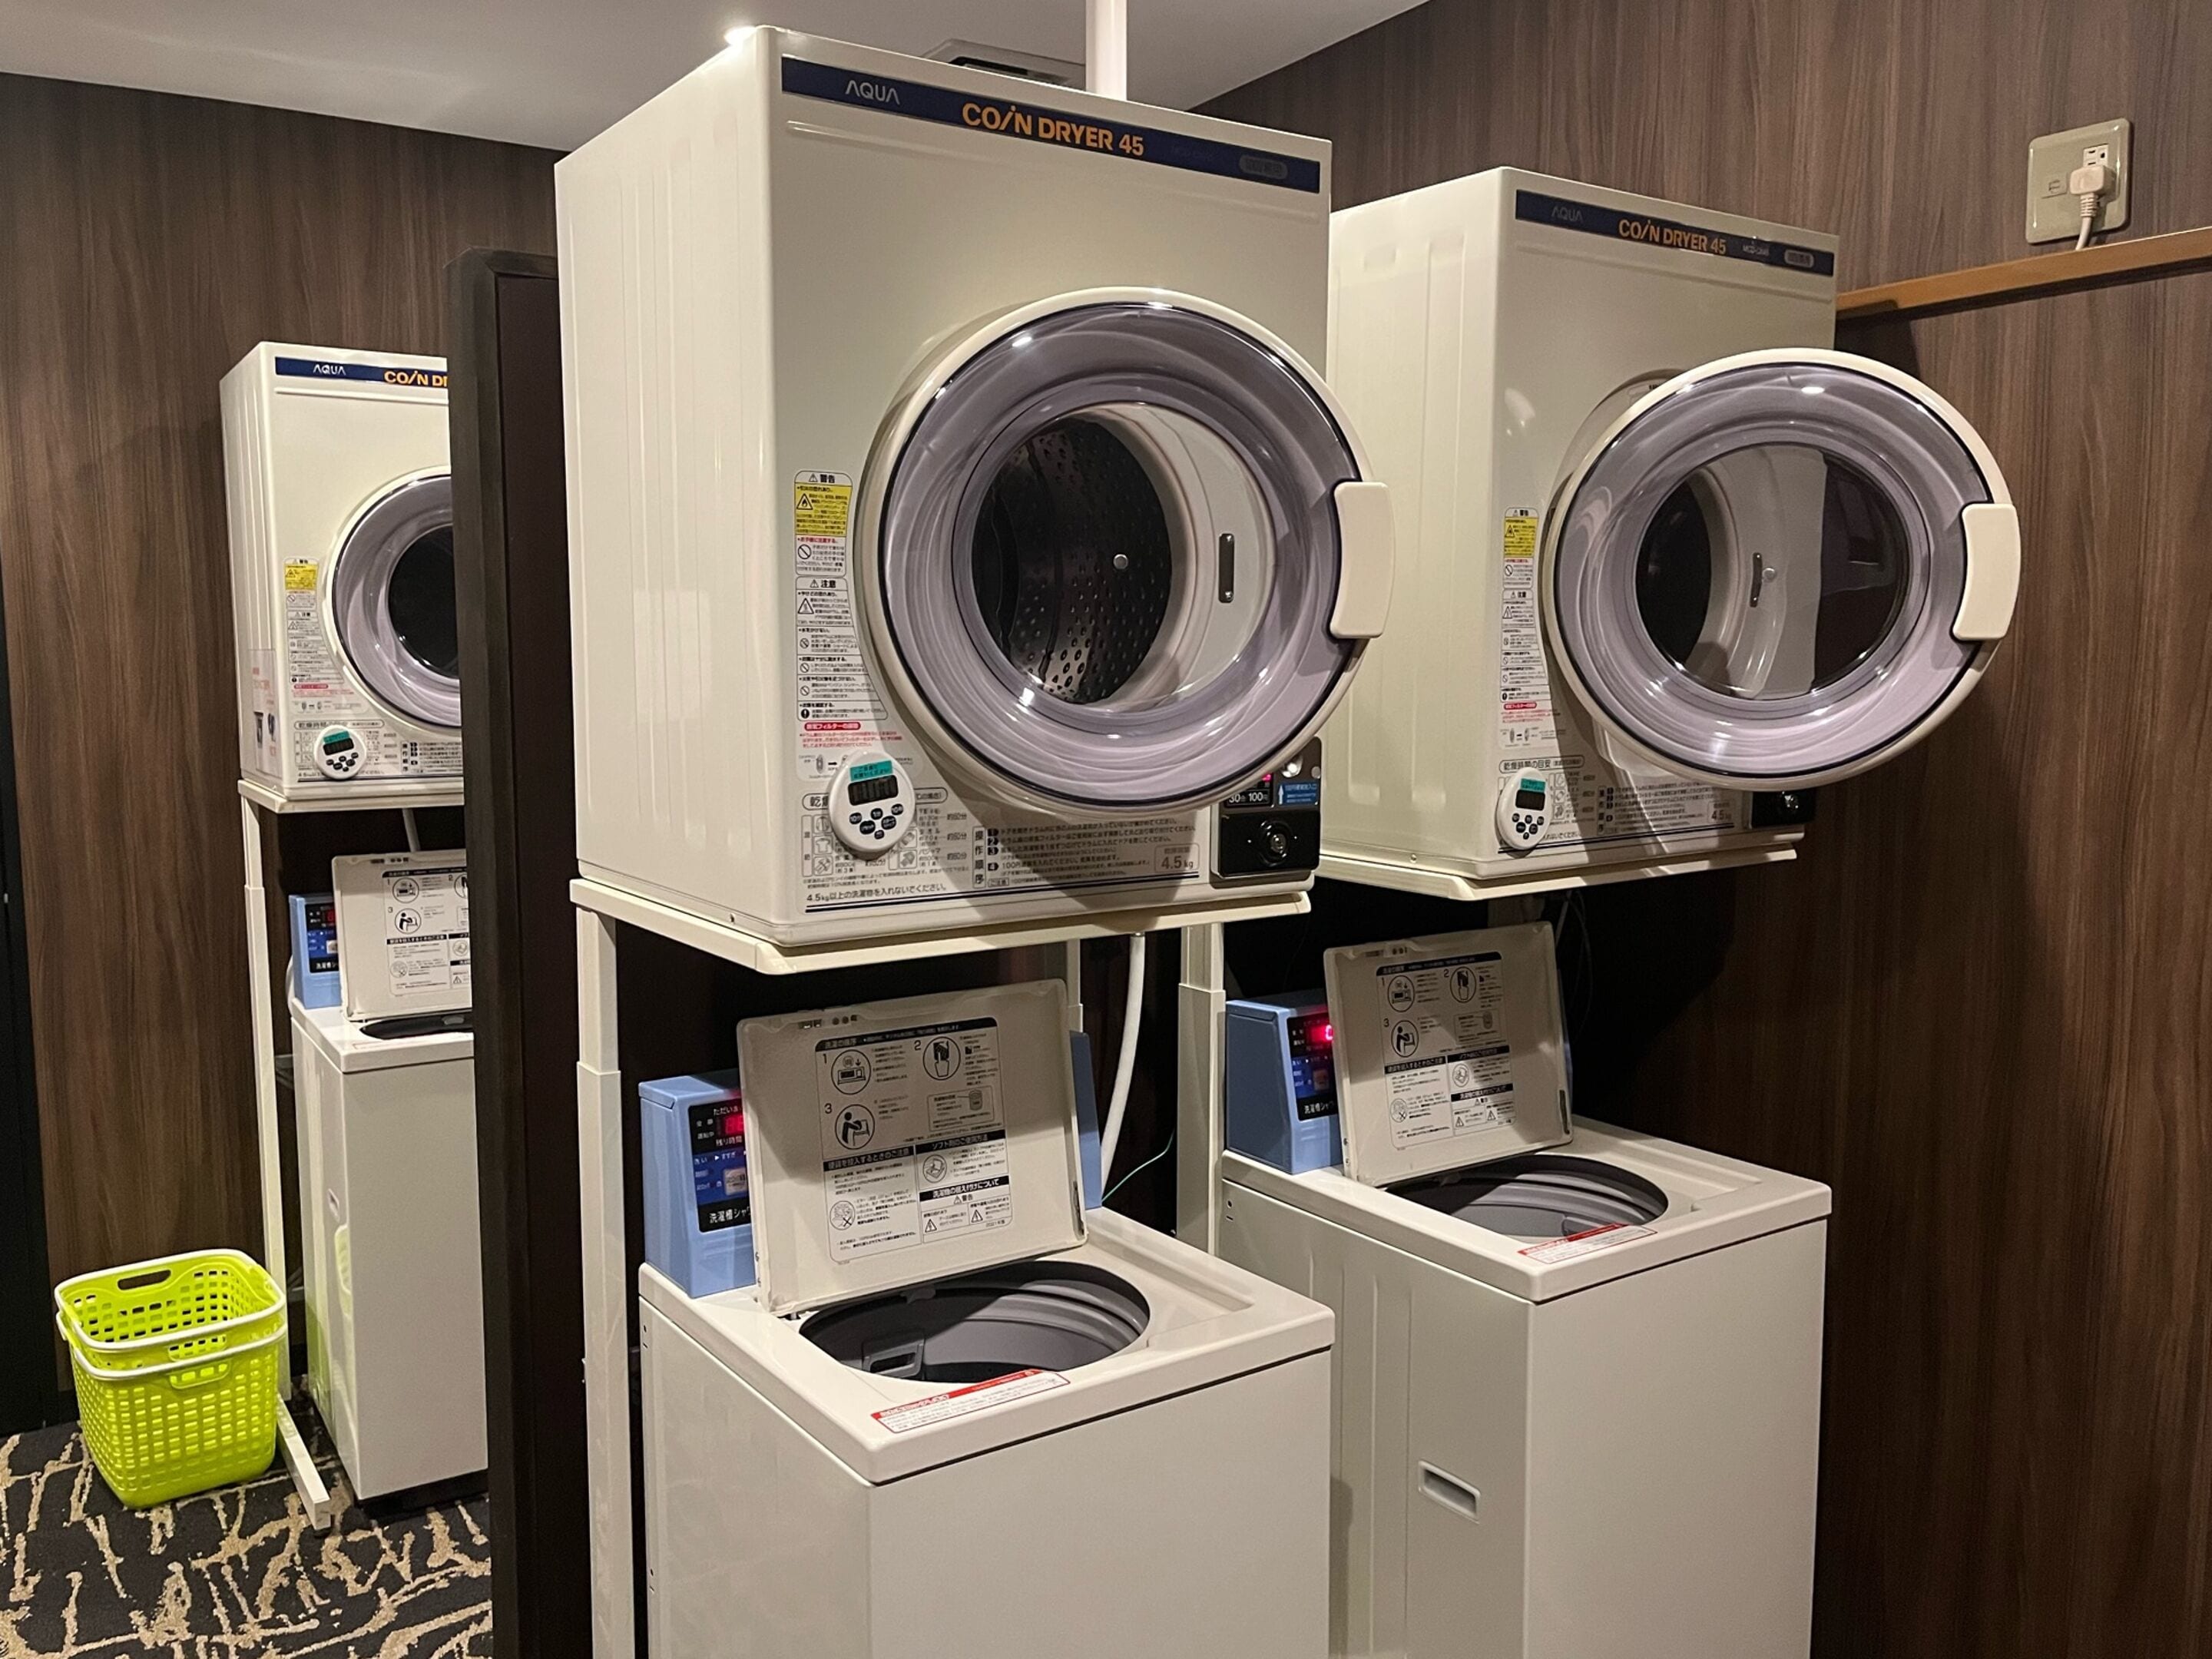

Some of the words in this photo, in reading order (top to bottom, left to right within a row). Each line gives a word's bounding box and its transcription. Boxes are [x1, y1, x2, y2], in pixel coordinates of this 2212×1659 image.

[846, 80, 900, 105] AQUA
[962, 102, 1033, 135] COIN
[1038, 116, 1114, 151] DRYER
[1118, 134, 1144, 156] 45
[1551, 205, 1583, 223] AQUA
[1618, 218, 1660, 243] COIN
[1664, 227, 1708, 253] DRYER
[1711, 239, 1727, 255] 45
[313, 363, 346, 376] AQUA
[384, 369, 429, 386] COIN
[1161, 855, 1182, 869] 4.5
[1443, 969, 1449, 978] 2
[1383, 1018, 1389, 1028] 3
[914, 1040, 922, 1051] 2
[823, 1054, 827, 1064] 1
[824, 1103, 833, 1114] 3
